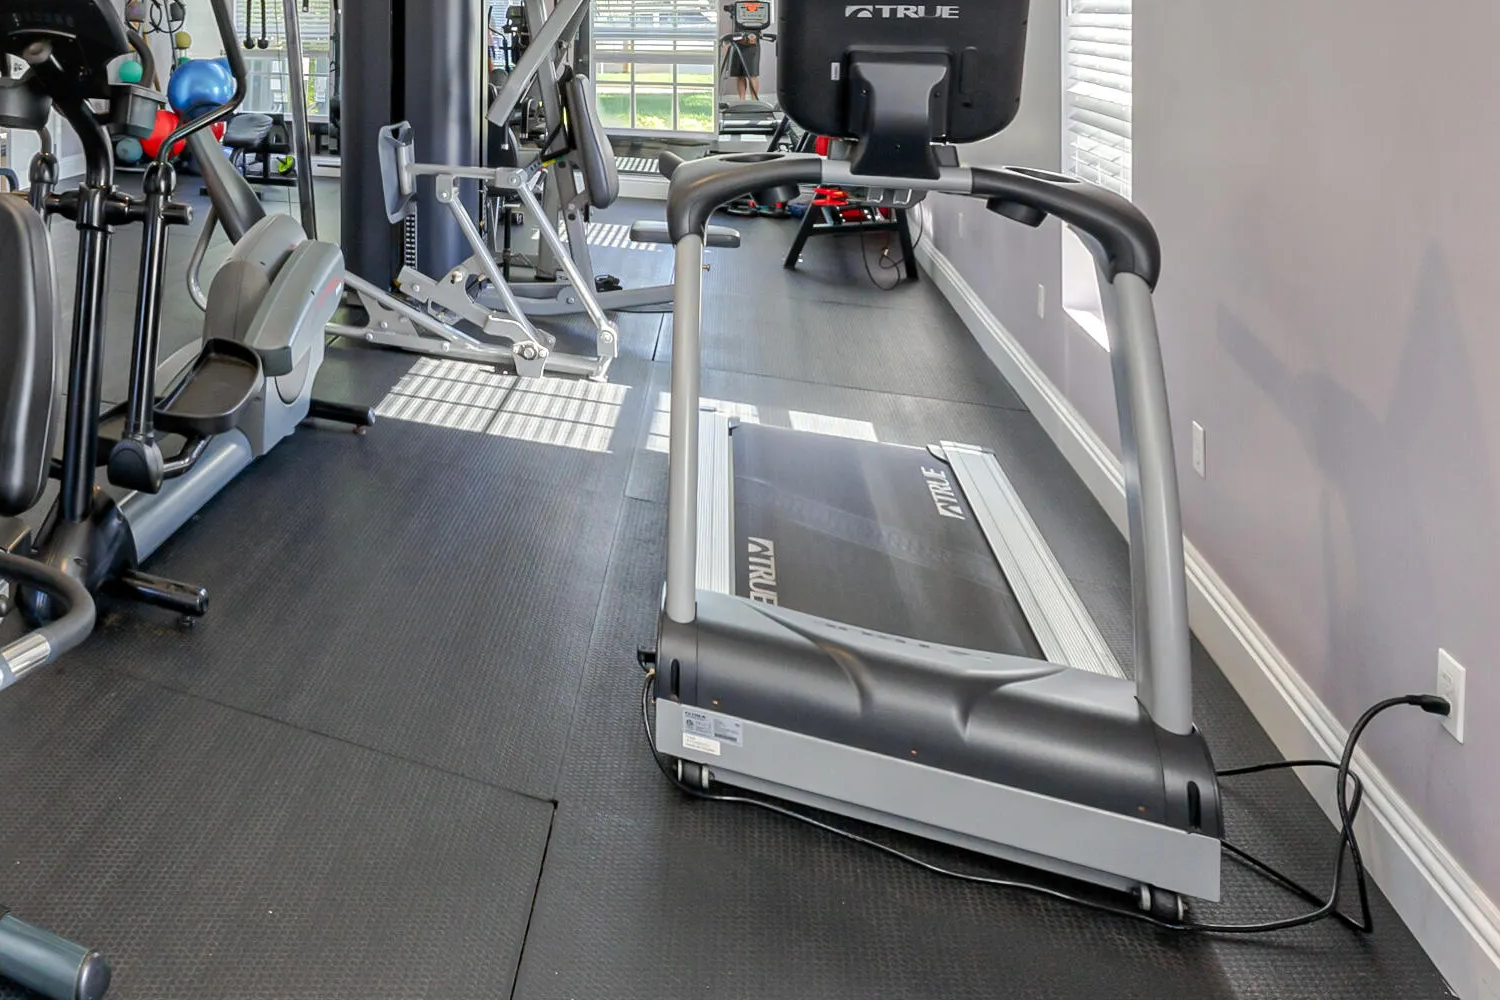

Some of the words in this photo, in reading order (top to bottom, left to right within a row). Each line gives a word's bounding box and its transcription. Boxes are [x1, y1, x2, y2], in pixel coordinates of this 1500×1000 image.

[875, 5, 959, 18] TRUE
[921, 466, 958, 505] TRUE
[748, 556, 778, 606] TRUE
